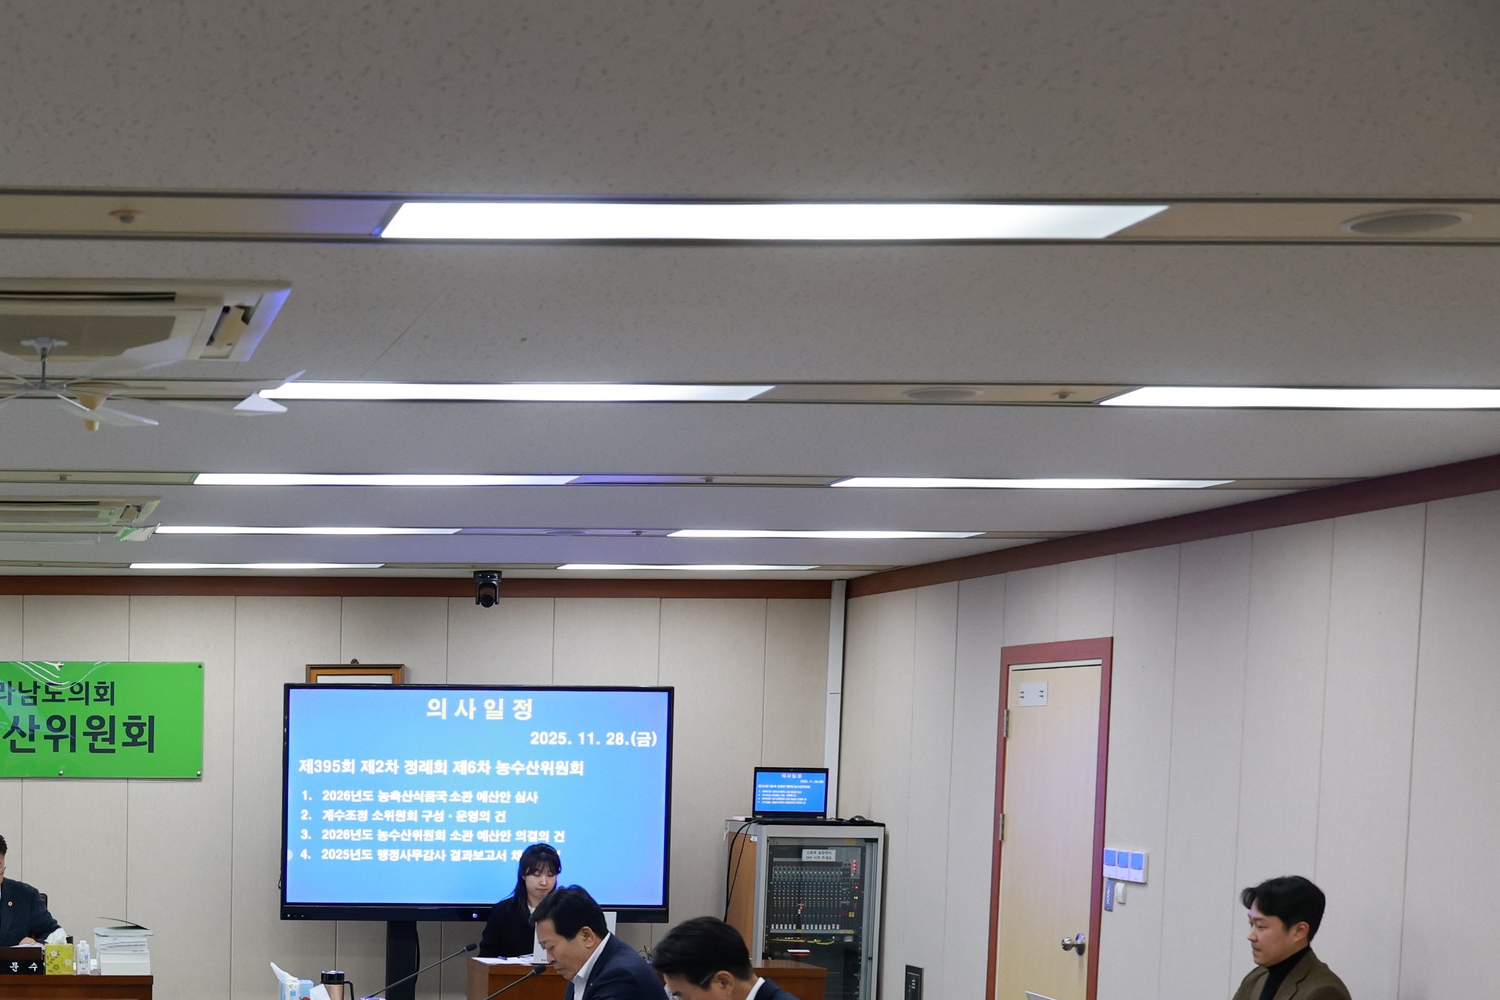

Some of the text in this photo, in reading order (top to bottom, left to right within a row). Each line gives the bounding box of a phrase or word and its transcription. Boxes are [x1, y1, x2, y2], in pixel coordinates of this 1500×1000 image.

[530, 731, 572, 745] 2025.
[578, 731, 601, 745] 11.
[298, 759, 584, 776] 제395회 제2차 정례회 제6차 농수산위원회
[301, 790, 312, 801] 1.
[322, 790, 374, 802] 2026년도
[449, 791, 473, 803] 소관
[476, 791, 511, 803] 예산안
[514, 791, 539, 804] 심사
[300, 810, 312, 821] 2.
[322, 809, 368, 822] 계수조정
[371, 810, 418, 822] 소위원회
[421, 810, 445, 822] 구성
[456, 810, 490, 822] 운영의
[494, 810, 506, 822] 건
[300, 829, 312, 840] 3.
[377, 829, 446, 841] 농수산위원회
[450, 830, 473, 842] 소관
[476, 830, 512, 842] 예산안
[554, 830, 565, 843] 건
[300, 849, 311, 860] 4.
[321, 849, 373, 861] 2025년도
[377, 849, 445, 862] 행정사무감사
[450, 850, 507, 862] 결과보고서
